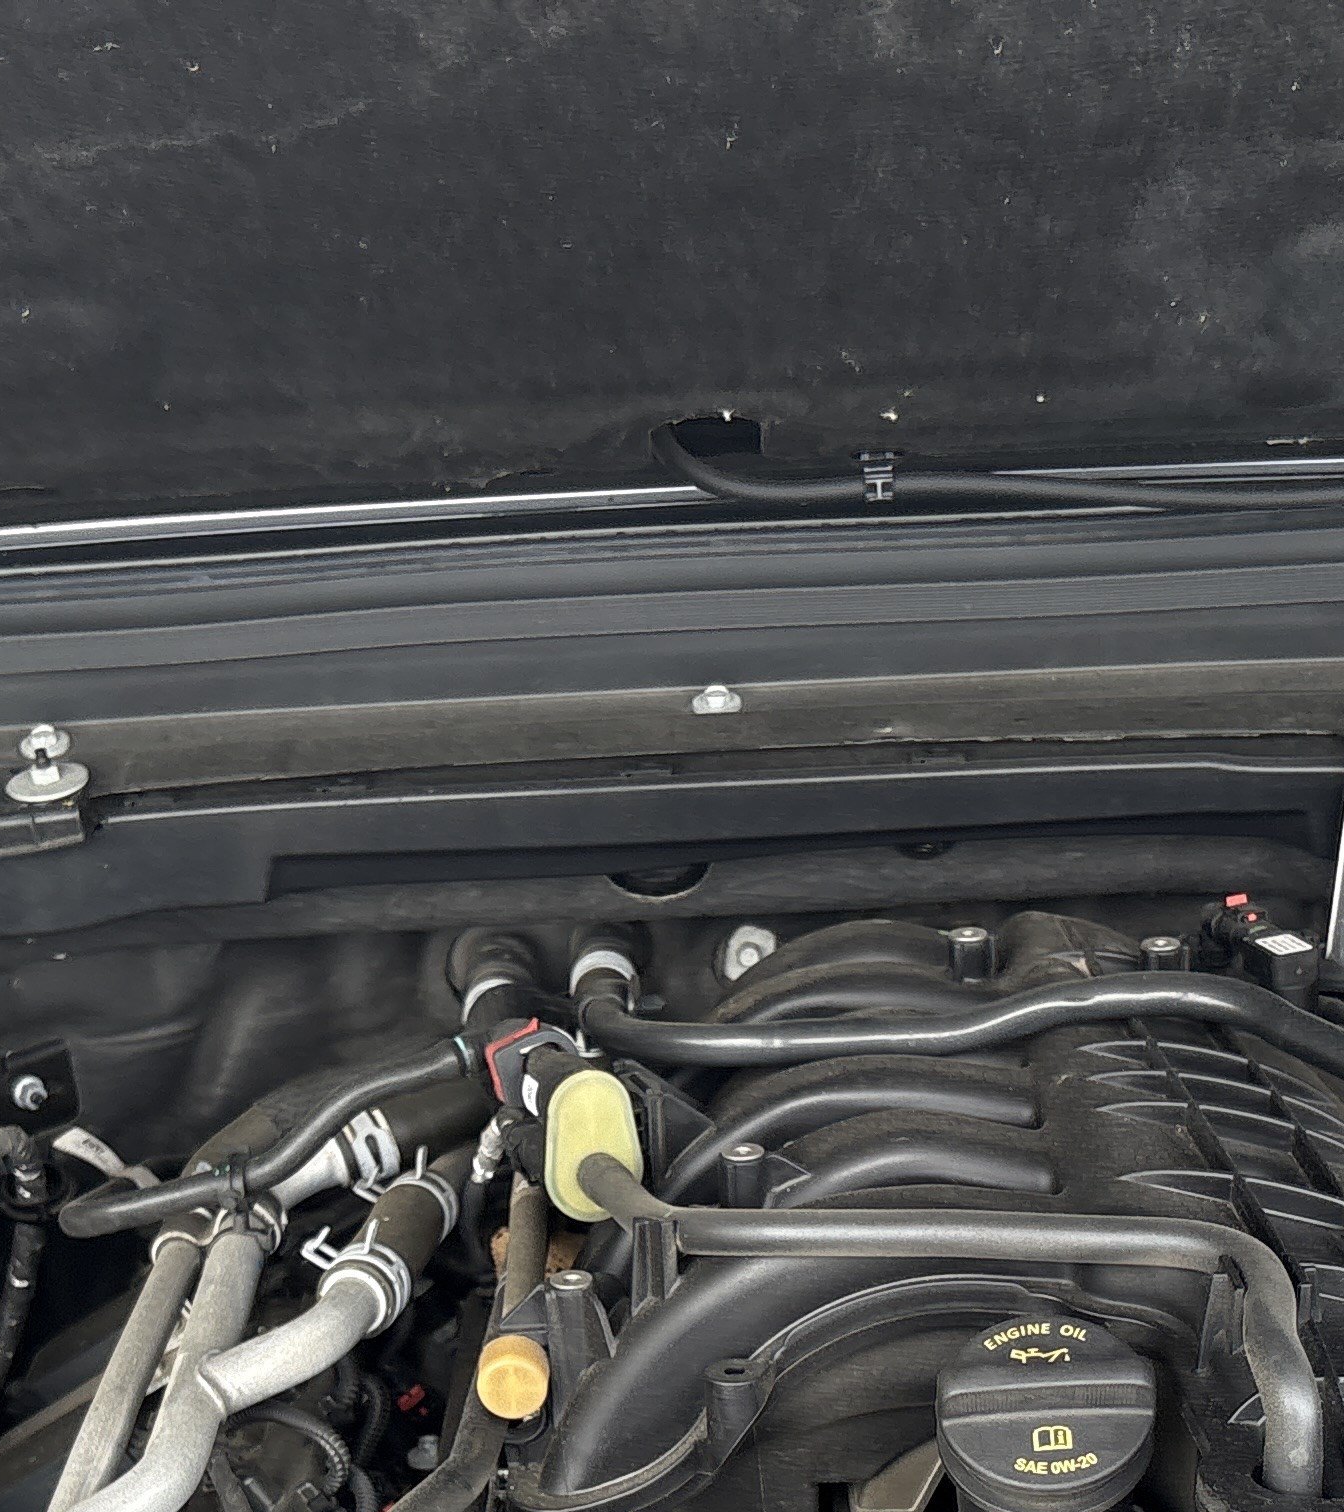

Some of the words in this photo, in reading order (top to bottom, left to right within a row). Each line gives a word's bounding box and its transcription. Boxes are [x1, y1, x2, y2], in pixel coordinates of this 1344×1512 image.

[983, 1323, 1051, 1351] ENGINE
[1059, 1324, 1087, 1342] OIL
[1014, 1458, 1048, 1475] SAE
[1051, 1453, 1098, 1475] 0W-20
